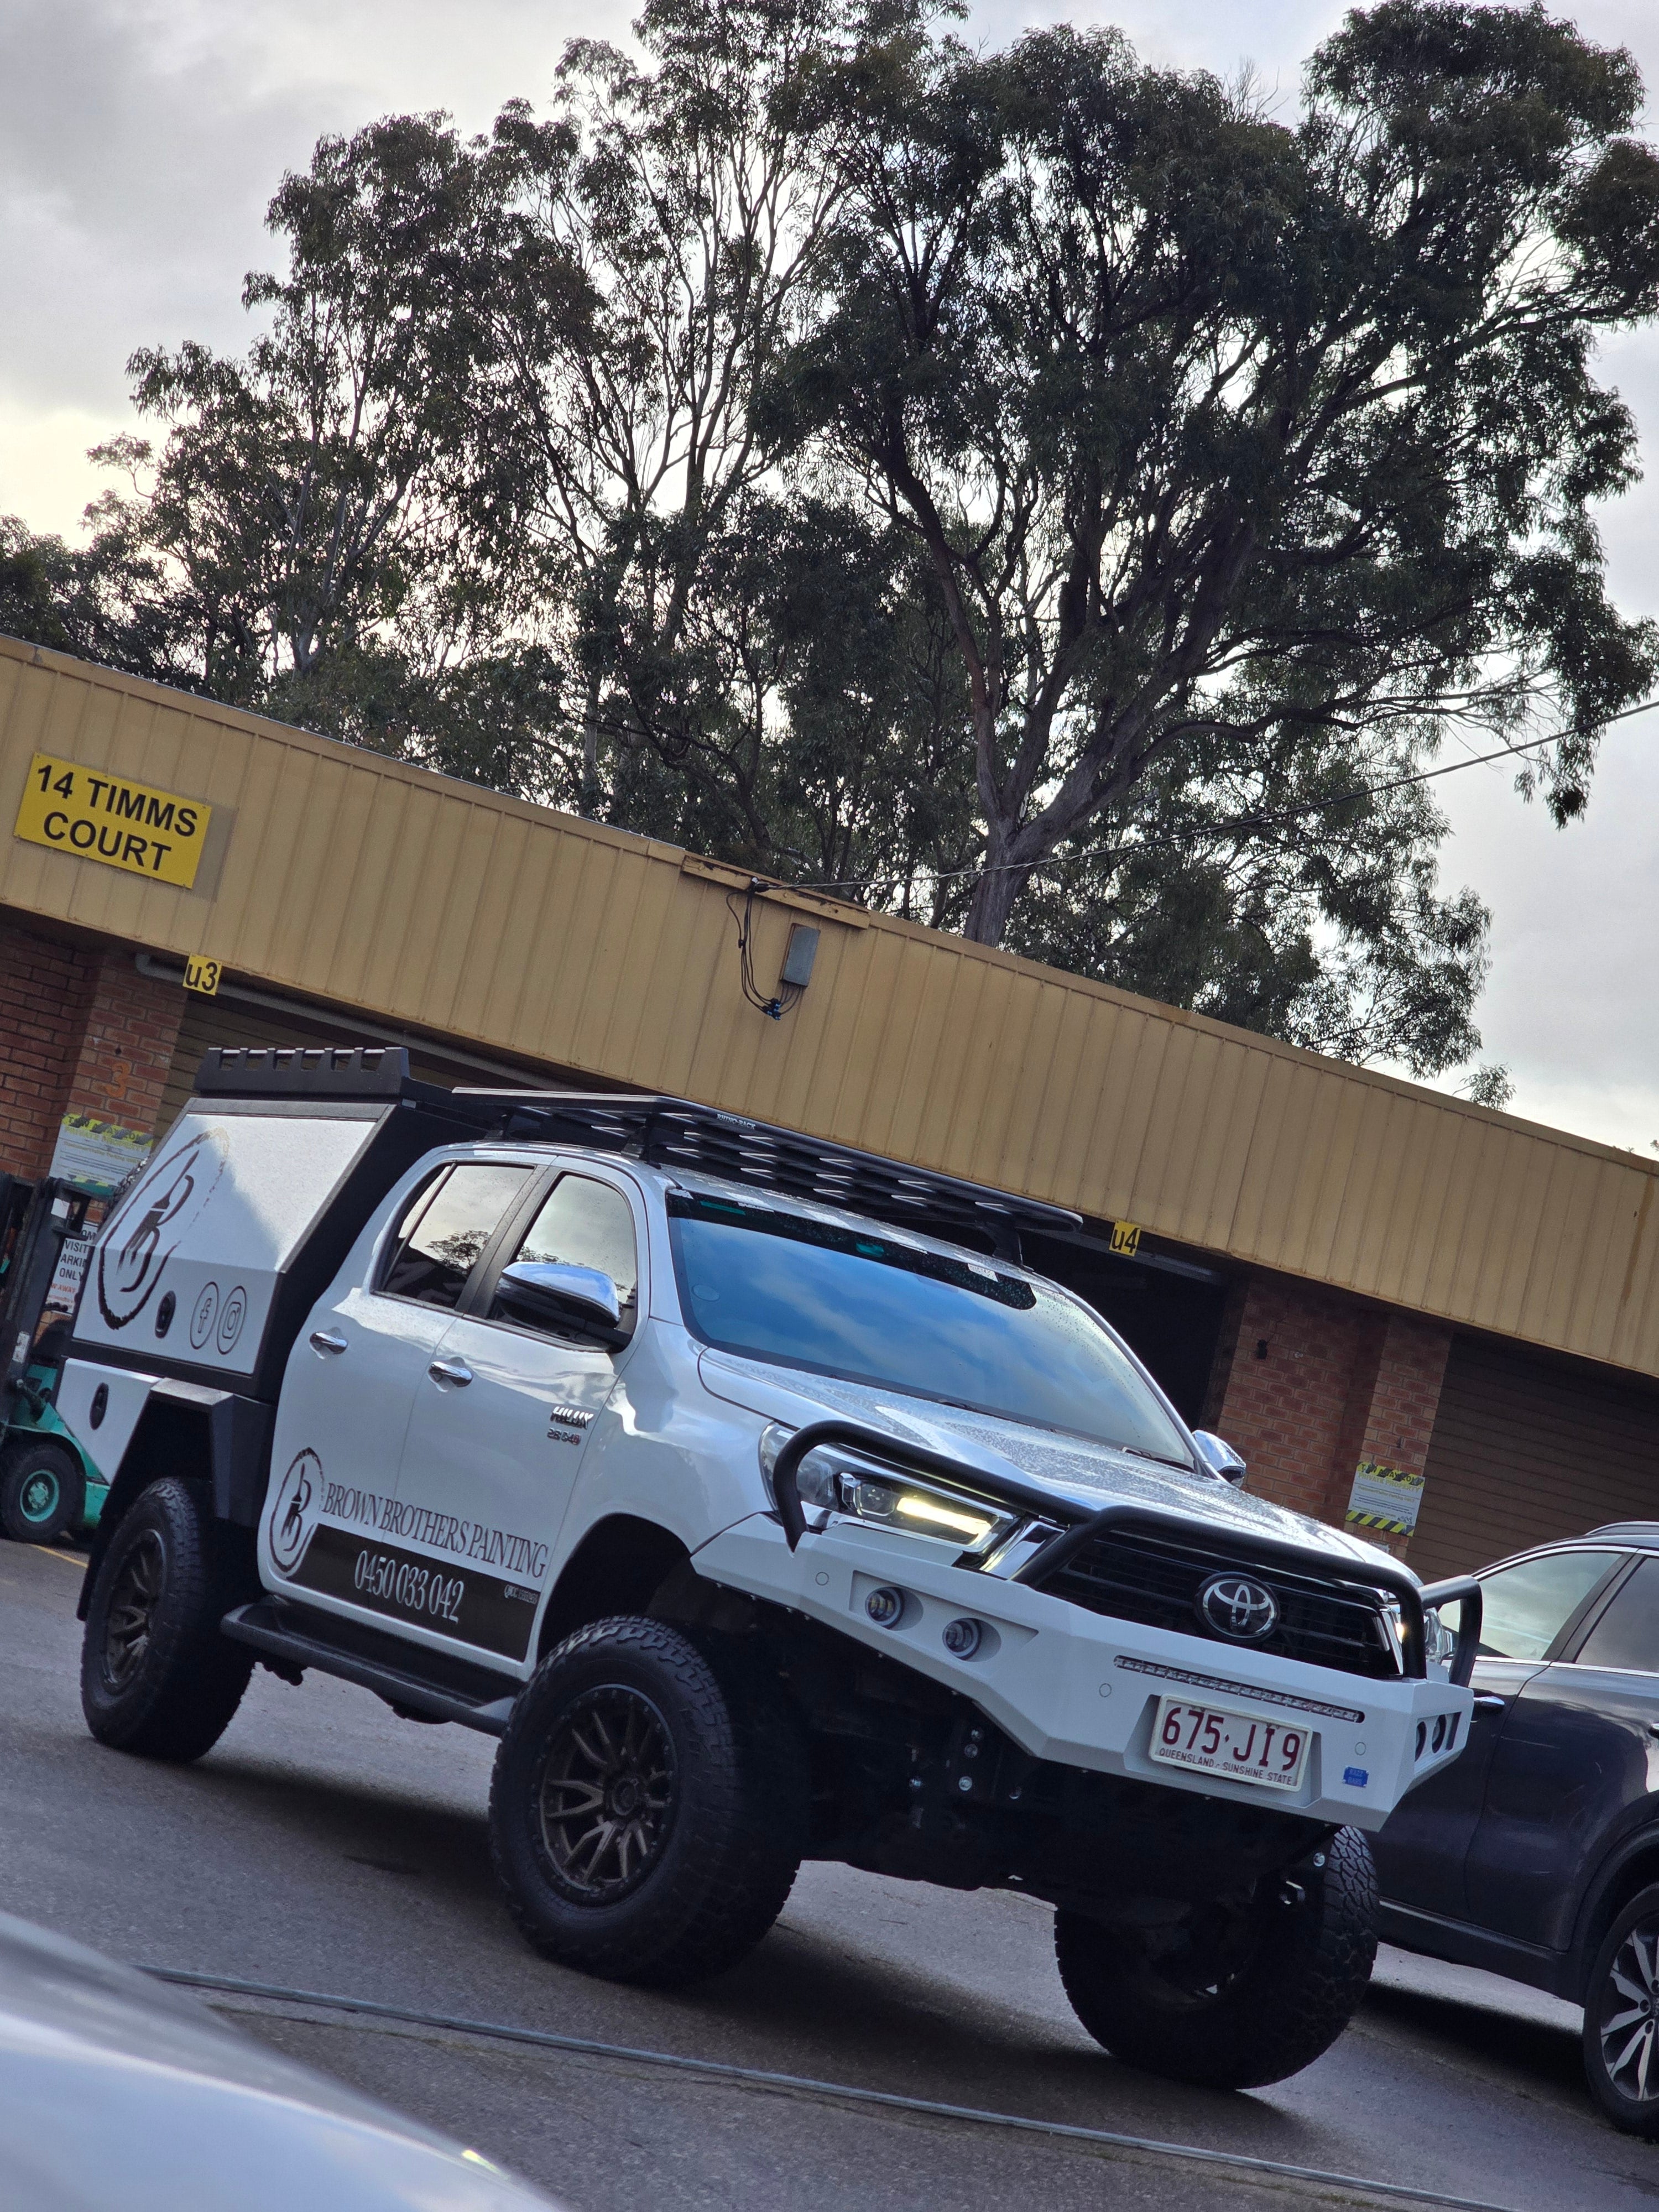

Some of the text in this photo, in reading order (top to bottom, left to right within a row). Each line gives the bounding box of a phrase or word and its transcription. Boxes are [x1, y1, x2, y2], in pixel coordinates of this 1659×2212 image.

[38, 765, 198, 837] 14 TIMMS
[43, 812, 171, 870] COURT
[186, 962, 218, 991] u3
[103, 1062, 131, 1098] 3
[65, 1239, 88, 1254] VISIT
[1112, 1228, 1140, 1253] u4
[60, 1254, 85, 1267] ARKI
[550, 1406, 594, 1430] HILUX
[321, 1483, 549, 1578] BROWN BROTHERS PAINTING
[354, 1550, 465, 1624] 0450 033 042
[1159, 1747, 1214, 1767] QUEENSLAND
[1222, 1762, 1263, 1779] SUNSHINE
[1267, 1772, 1292, 1785] STATE
